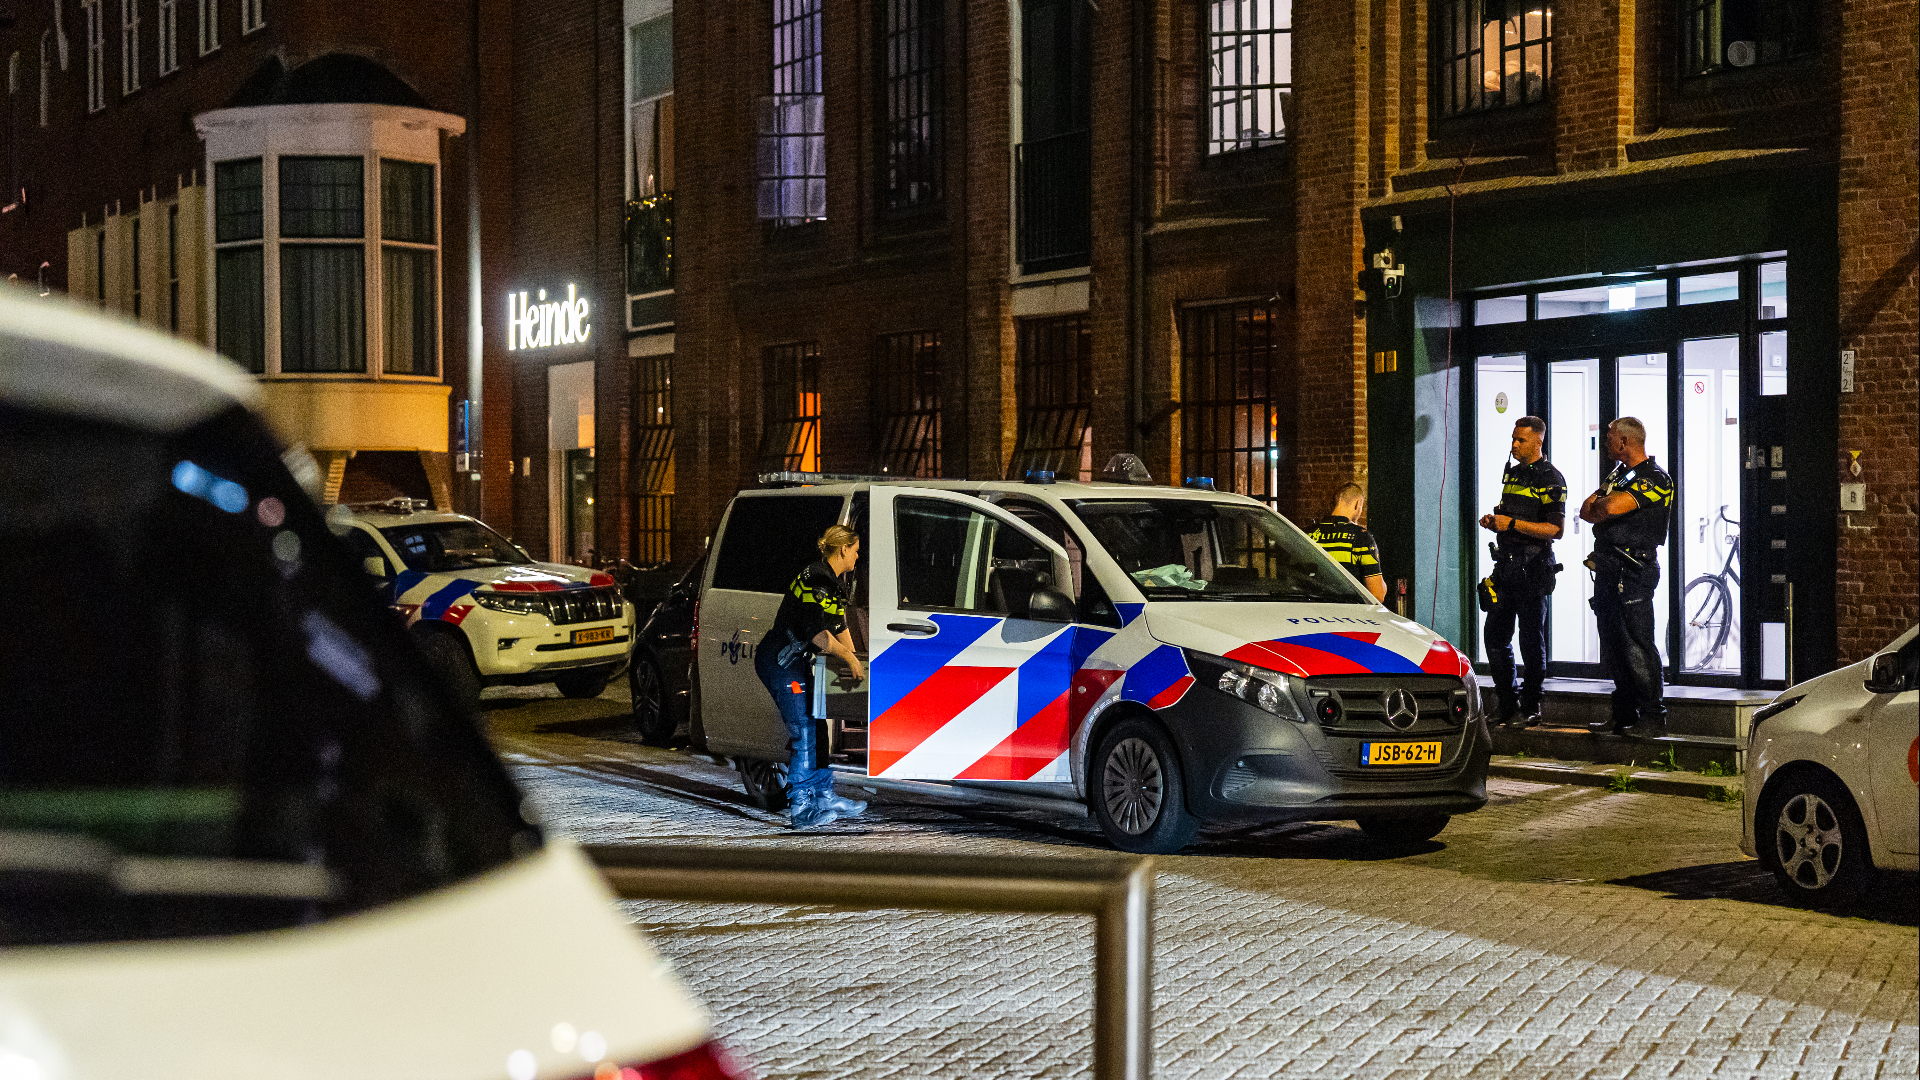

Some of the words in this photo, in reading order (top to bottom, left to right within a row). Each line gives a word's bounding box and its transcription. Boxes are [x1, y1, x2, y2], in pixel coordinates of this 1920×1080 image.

[509, 283, 590, 351] Heinde
[1850, 491, 1857, 503] B
[1286, 617, 1380, 625] POLITIE
[721, 634, 756, 664] POLI
[1374, 745, 1437, 761] JSB-62-H
